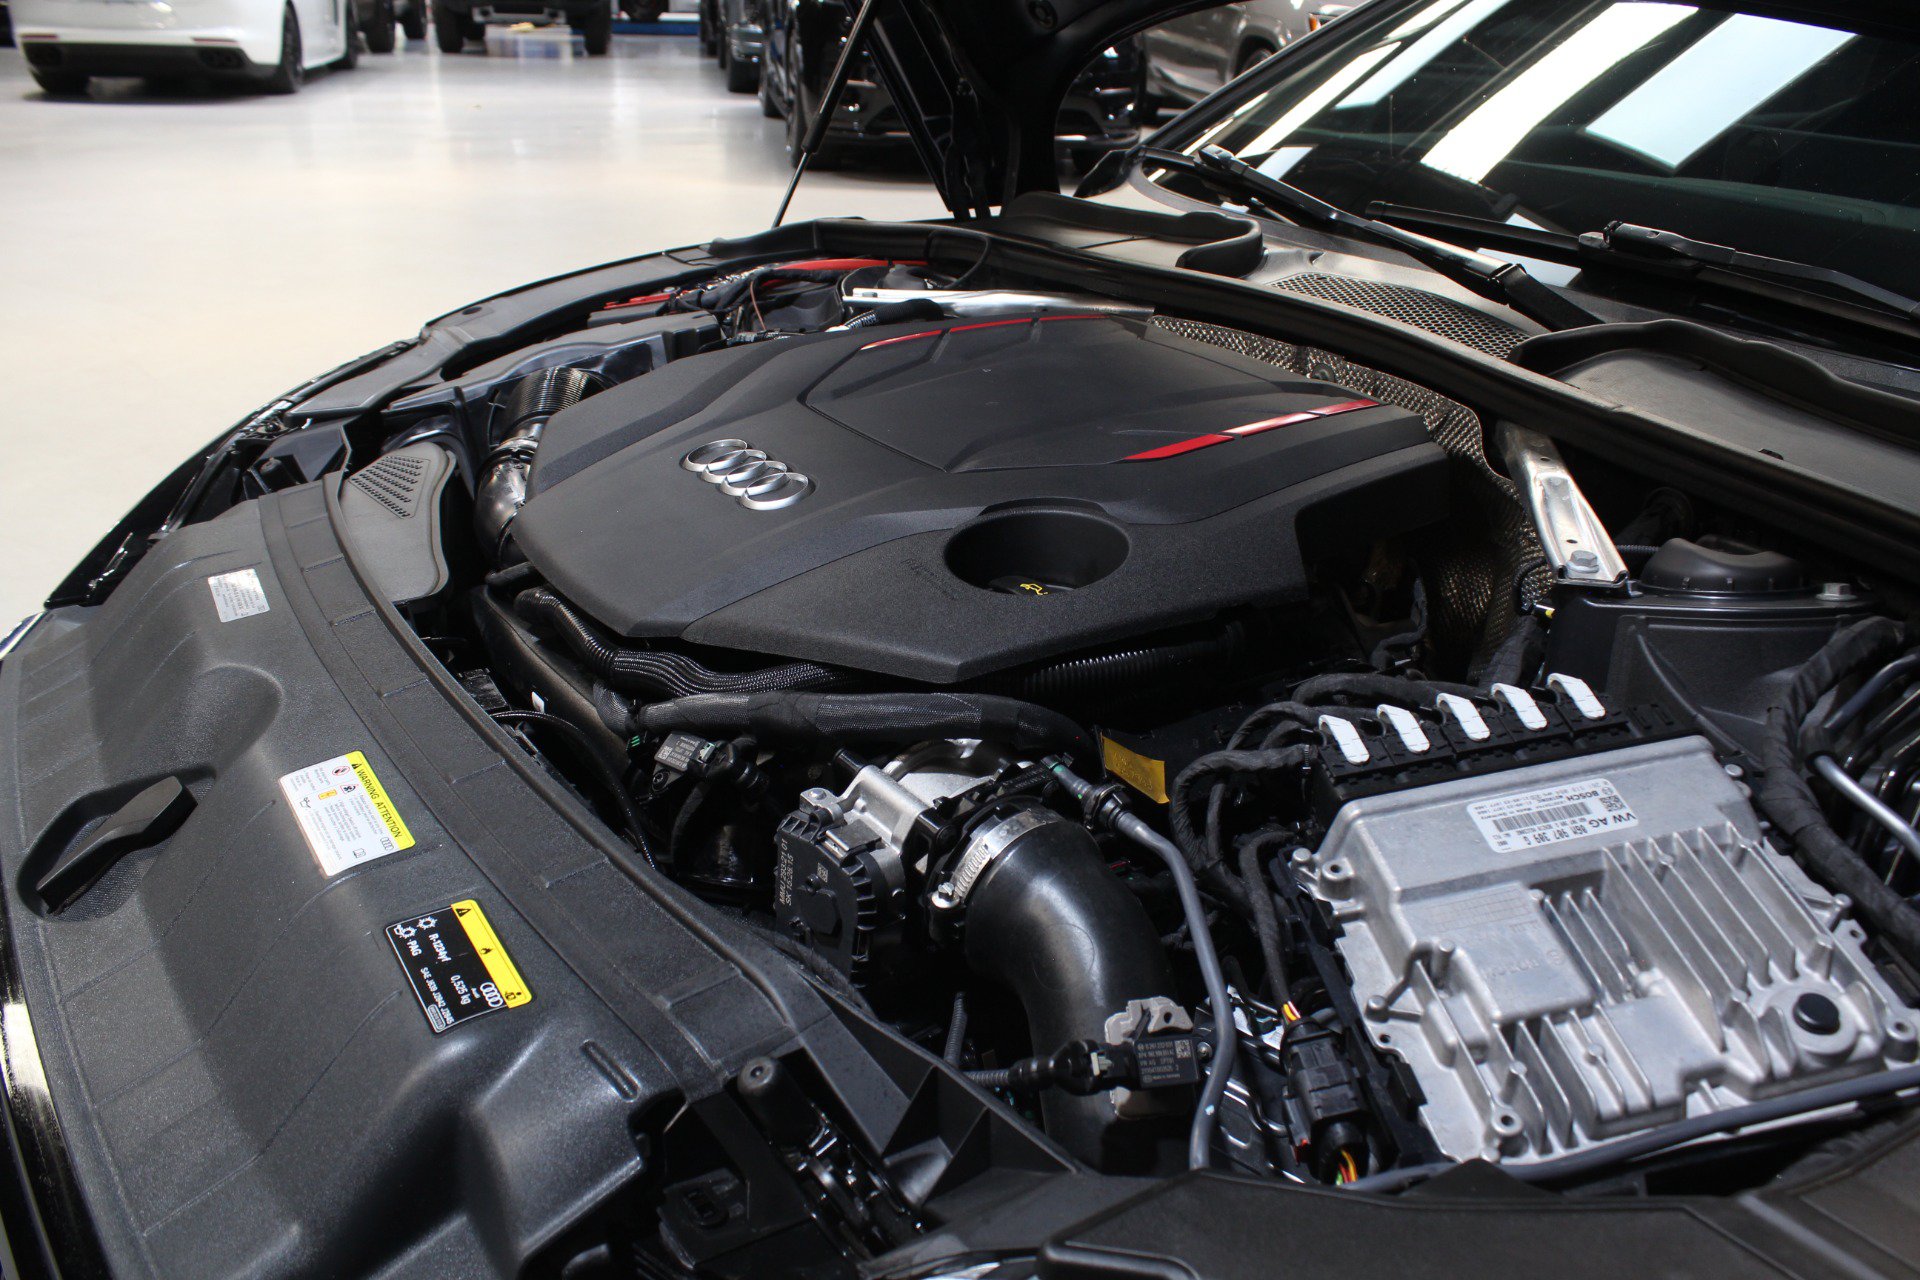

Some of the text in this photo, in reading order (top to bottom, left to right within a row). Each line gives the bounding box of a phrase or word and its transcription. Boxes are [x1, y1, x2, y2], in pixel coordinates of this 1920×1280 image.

[1566, 791, 1598, 801] BOSCH
[357, 770, 379, 799] WARNING
[376, 802, 402, 837] ATTENTION
[1589, 818, 1607, 827] AG
[1613, 813, 1636, 823] VW
[1534, 832, 1550, 843] 309
[1554, 829, 1569, 839] 907
[421, 968, 431, 979] SAE
[429, 934, 470, 1004] R-1234yf 0,525 kg
